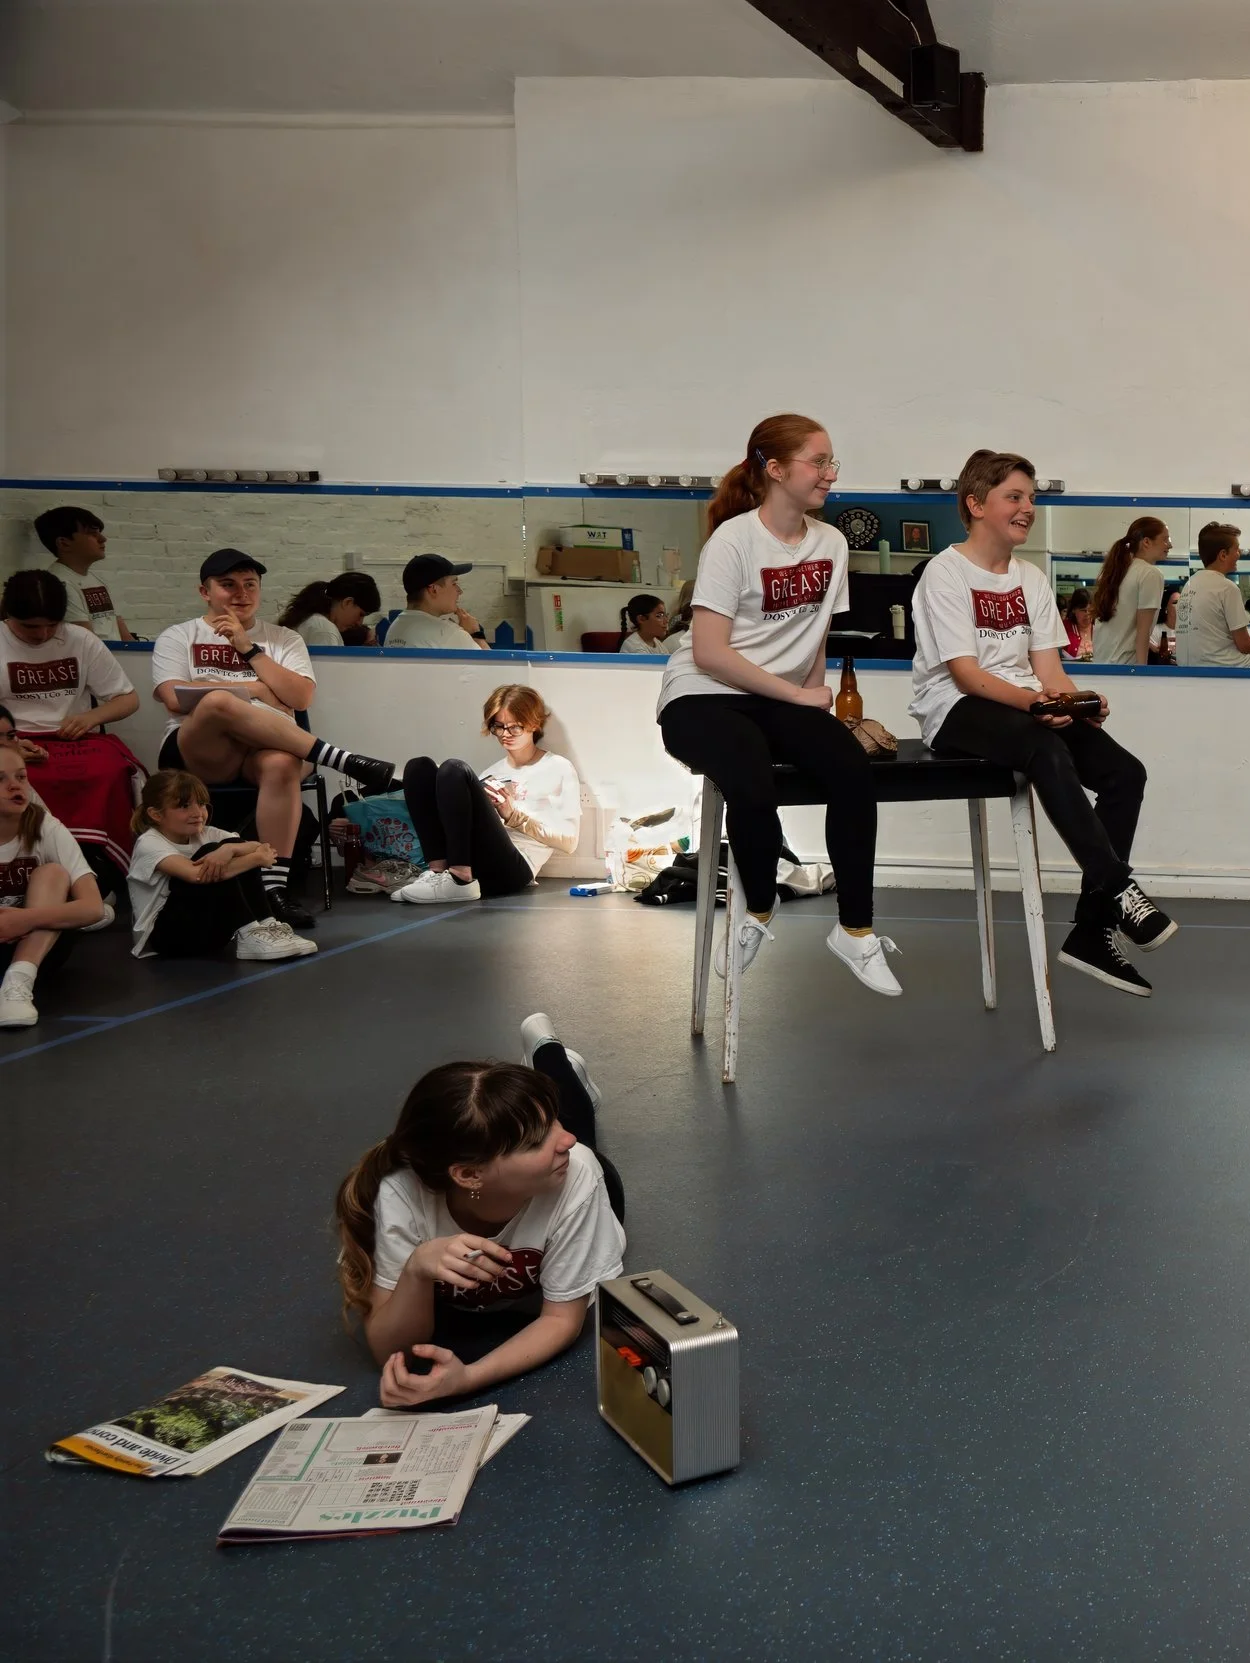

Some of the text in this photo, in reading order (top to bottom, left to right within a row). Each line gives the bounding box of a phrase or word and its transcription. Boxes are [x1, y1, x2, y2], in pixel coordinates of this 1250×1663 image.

[772, 571, 829, 600] GREASE
[980, 596, 1026, 621] GREAS
[201, 650, 247, 665] GREA
[17, 665, 77, 684] GREASE
[88, 1428, 117, 1441] con
[110, 1438, 141, 1451] and
[141, 1448, 180, 1465] Divide
[319, 1506, 441, 1524] Puzzles
